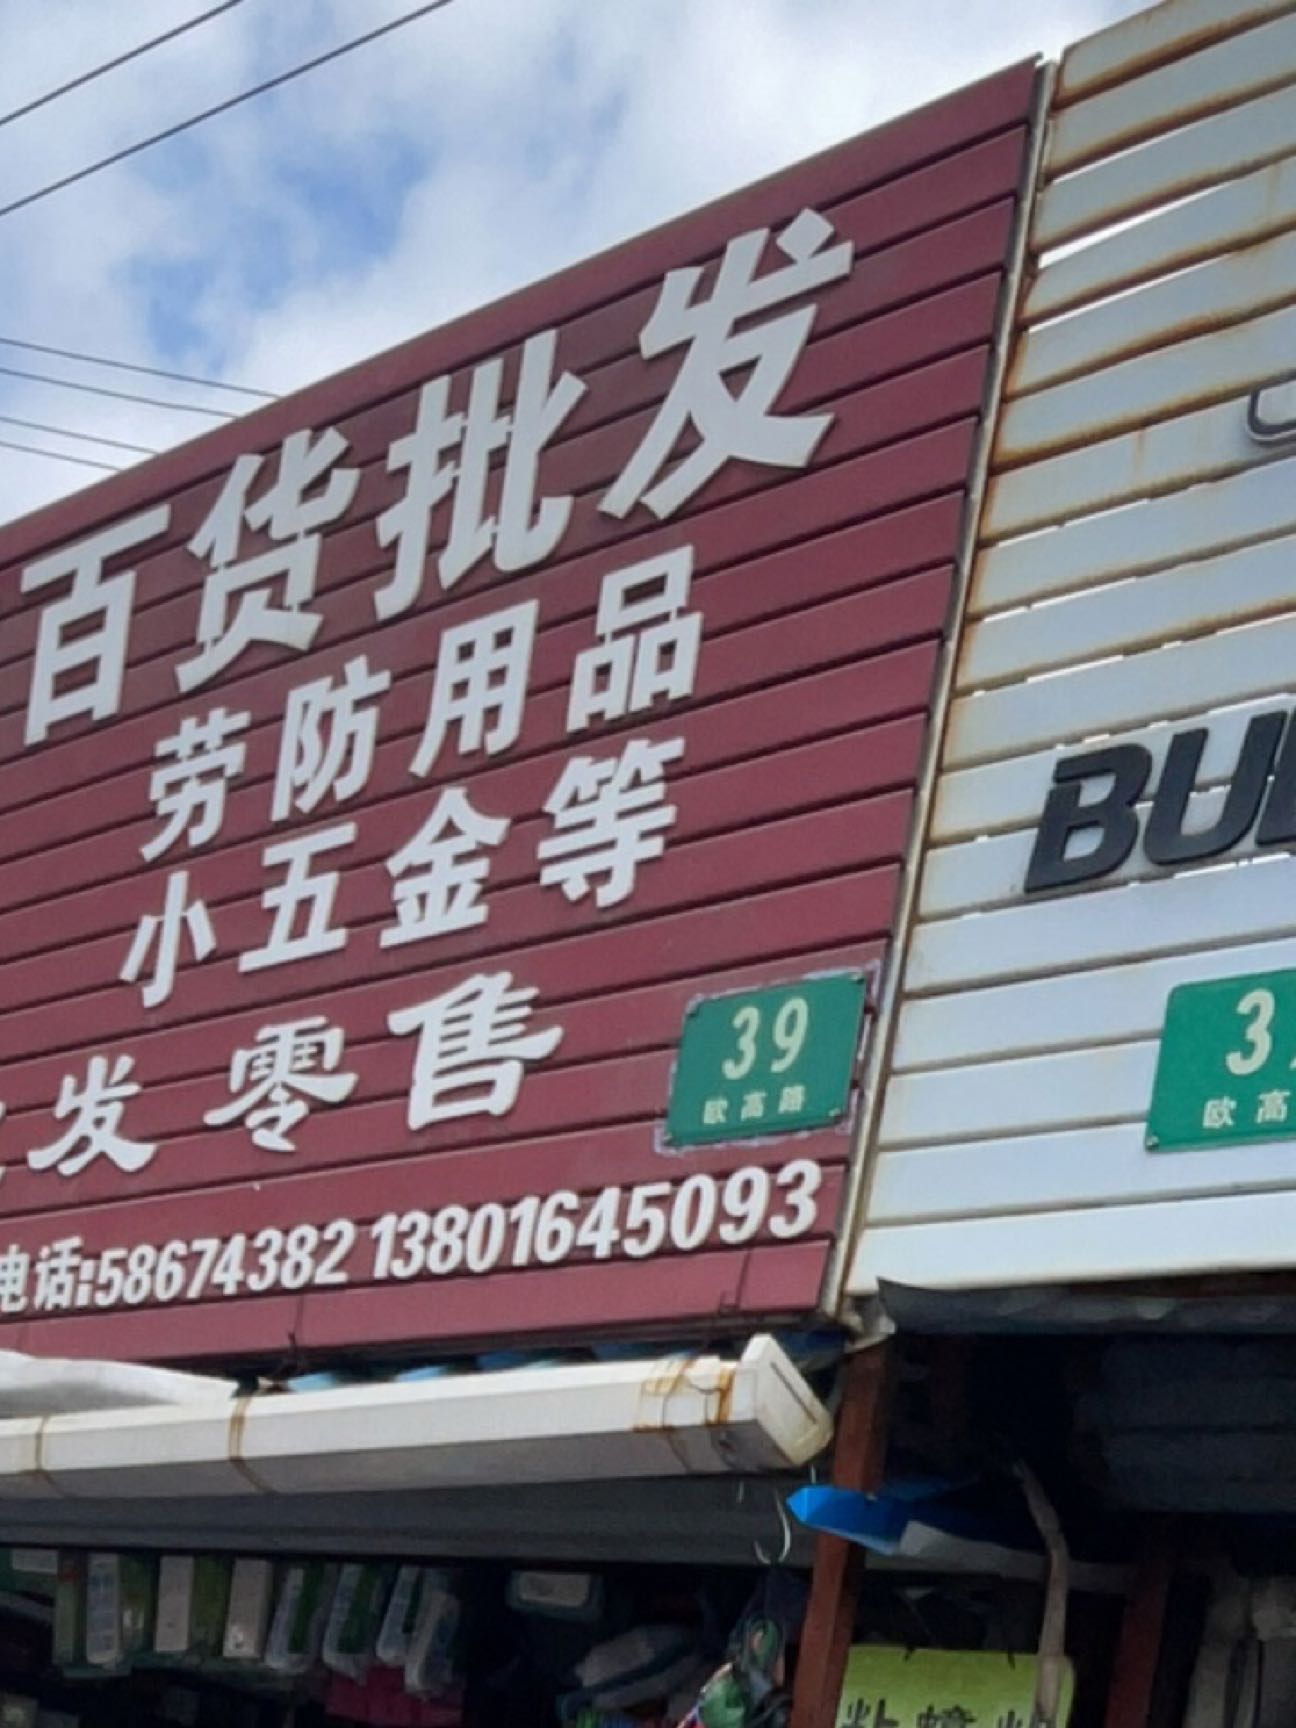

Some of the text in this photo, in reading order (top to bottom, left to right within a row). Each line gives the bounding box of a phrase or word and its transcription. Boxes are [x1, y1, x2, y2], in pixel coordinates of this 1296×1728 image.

[140, 545, 703, 861] 劳防用品
[118, 737, 685, 1009] 小五金等
[1024, 706, 1296, 893] BU
[722, 996, 808, 1080] 39
[1225, 988, 1296, 1075] 3
[370, 1158, 823, 1280] 13801645093
